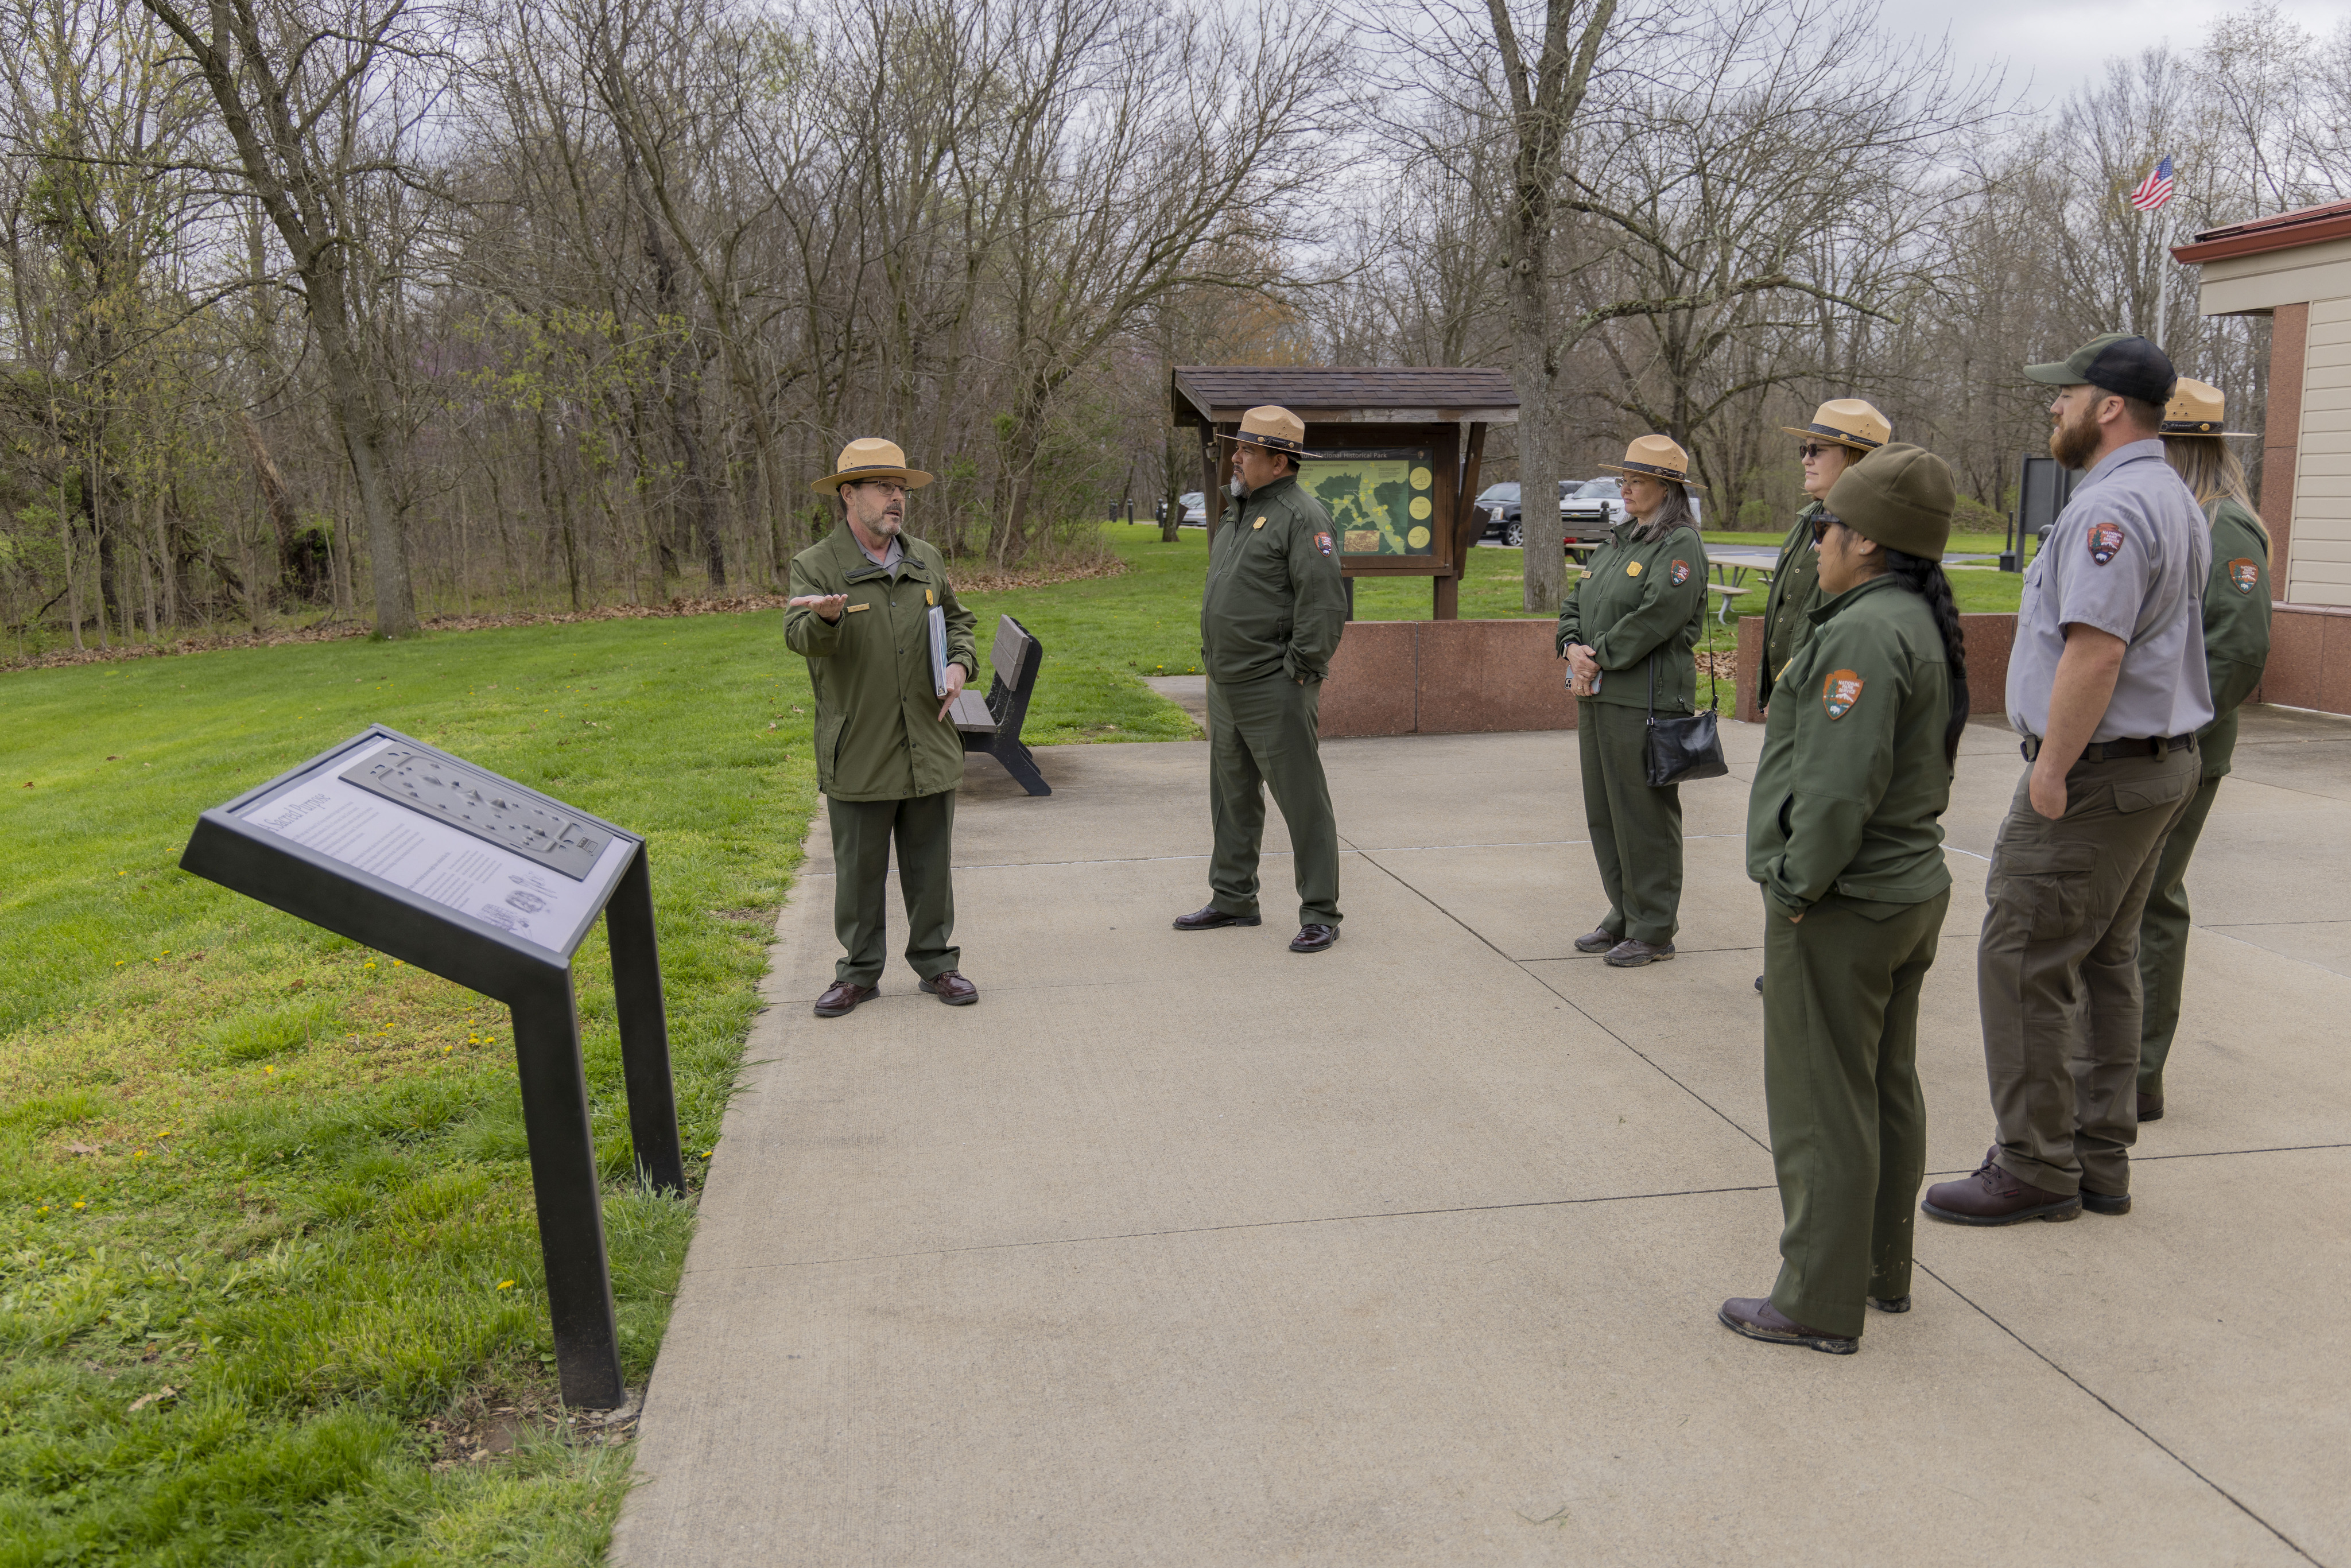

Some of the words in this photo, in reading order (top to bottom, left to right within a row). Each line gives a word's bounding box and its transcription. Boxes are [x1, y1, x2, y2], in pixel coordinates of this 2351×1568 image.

[288, 793, 331, 814] Purpose
[257, 822, 280, 832] A
[264, 807, 304, 829] Sacred
